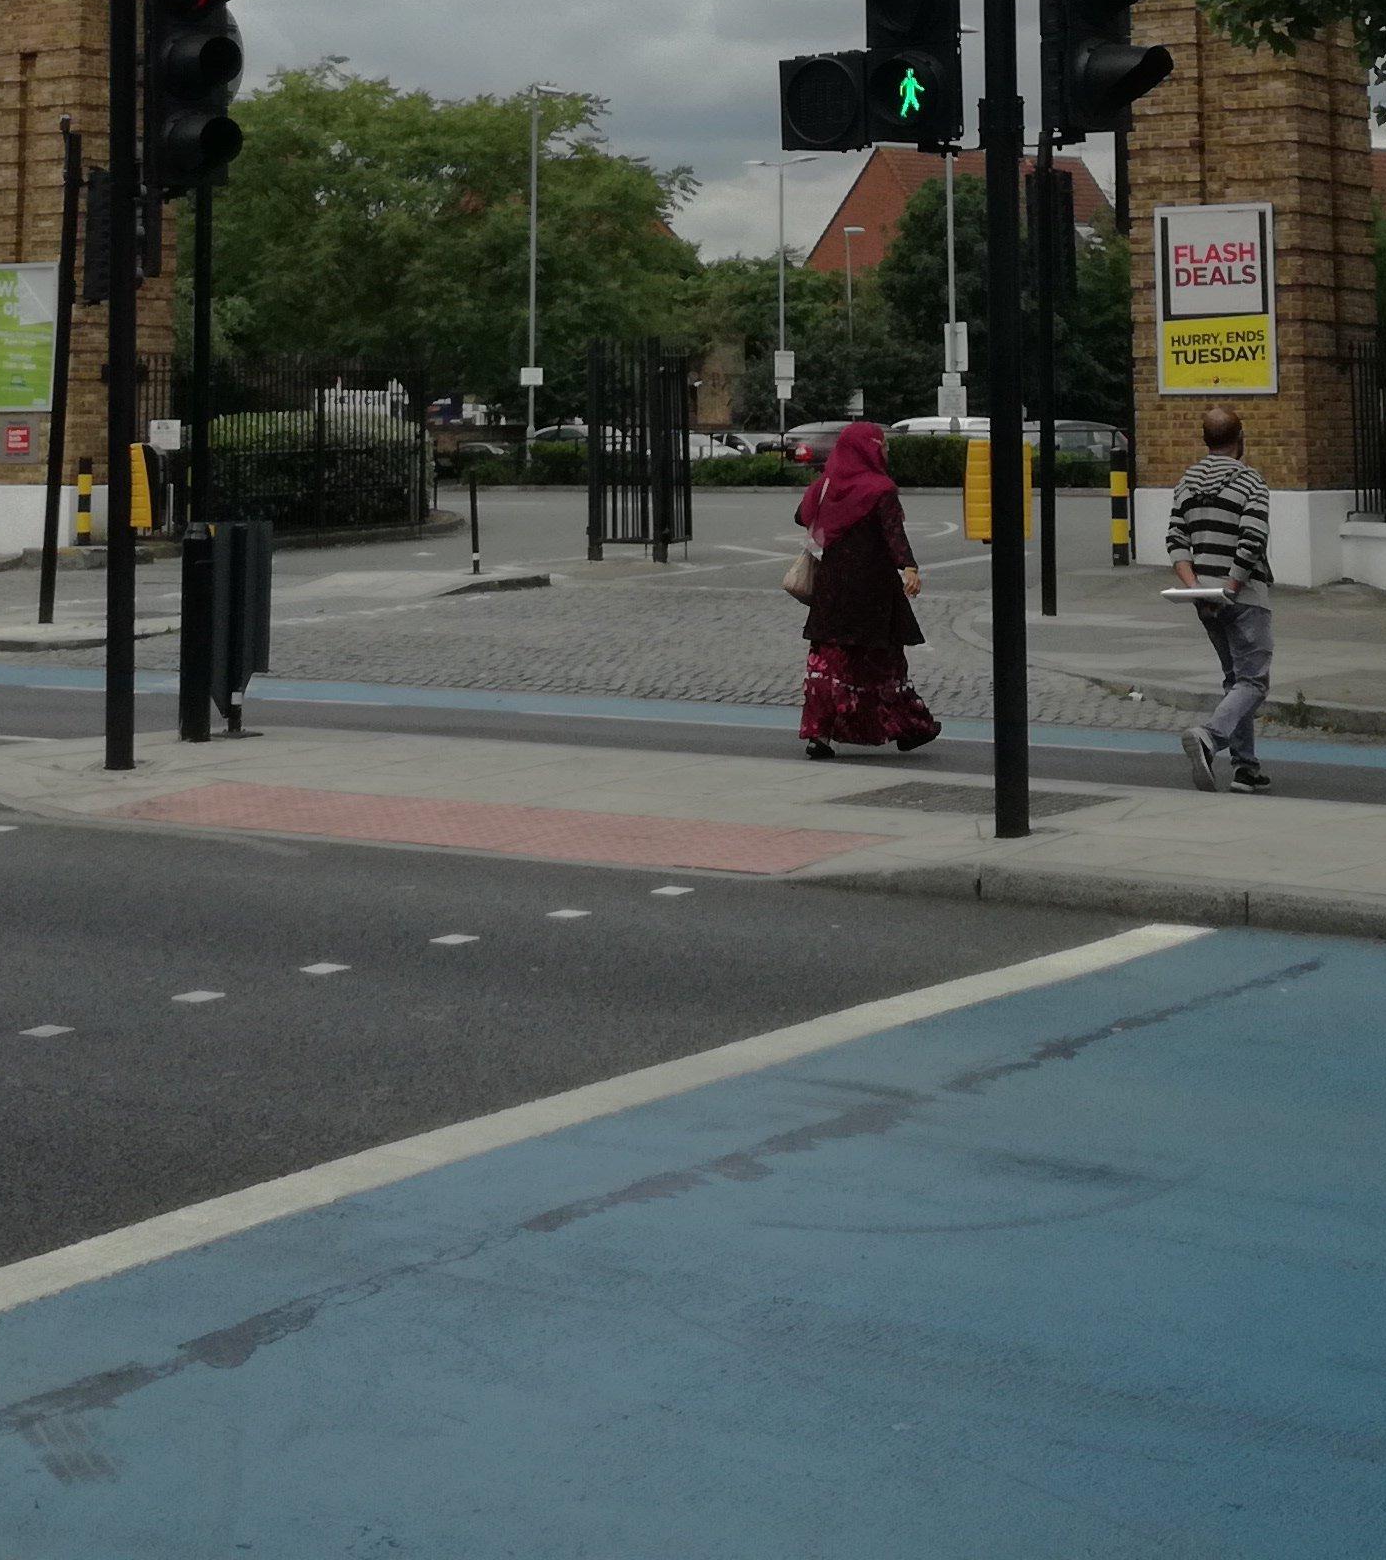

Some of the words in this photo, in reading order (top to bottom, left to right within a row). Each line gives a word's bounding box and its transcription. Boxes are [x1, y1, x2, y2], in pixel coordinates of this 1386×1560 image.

[1173, 242, 1256, 265] FLASH
[1174, 265, 1257, 288] DEALS
[1170, 331, 1223, 348] HURRY,
[1226, 329, 1265, 344] ENDS
[1170, 344, 1266, 366] TUESDAY!
